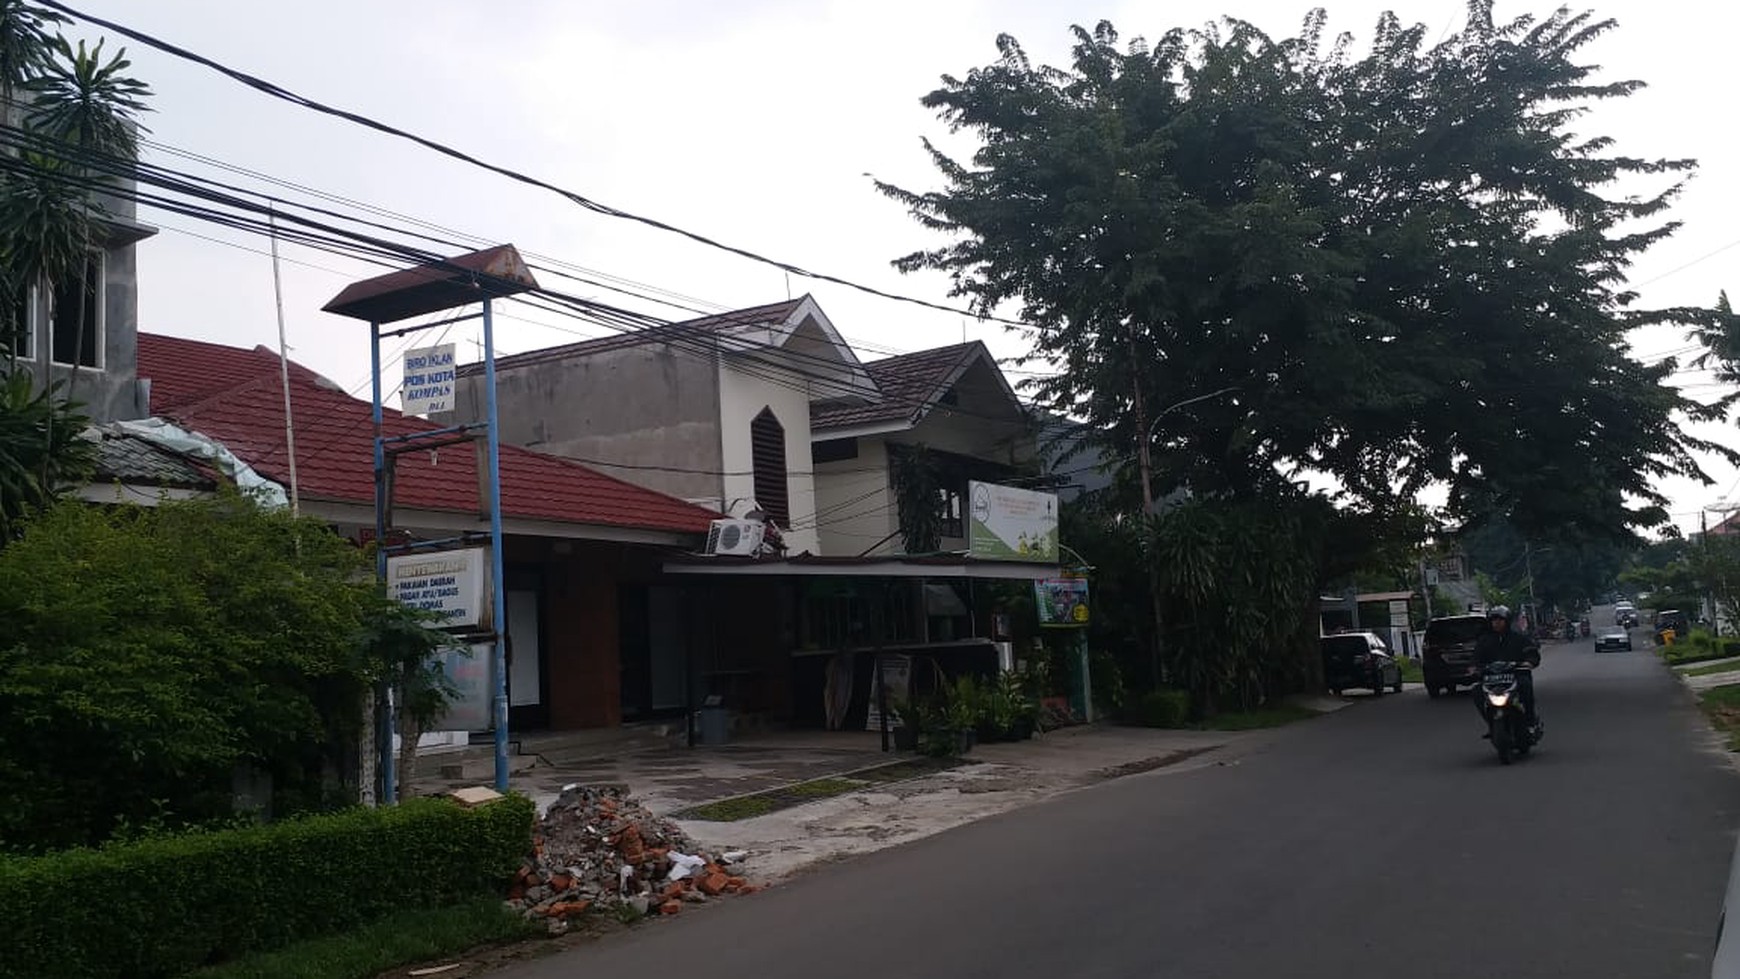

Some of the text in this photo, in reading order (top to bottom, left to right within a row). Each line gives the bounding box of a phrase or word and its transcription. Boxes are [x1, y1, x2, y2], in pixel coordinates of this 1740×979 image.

[407, 353, 452, 369] BIRO IKLAN
[404, 371, 454, 386] POS KOTA
[407, 386, 451, 400] KOMPAS
[430, 576, 455, 587] DAERAH
